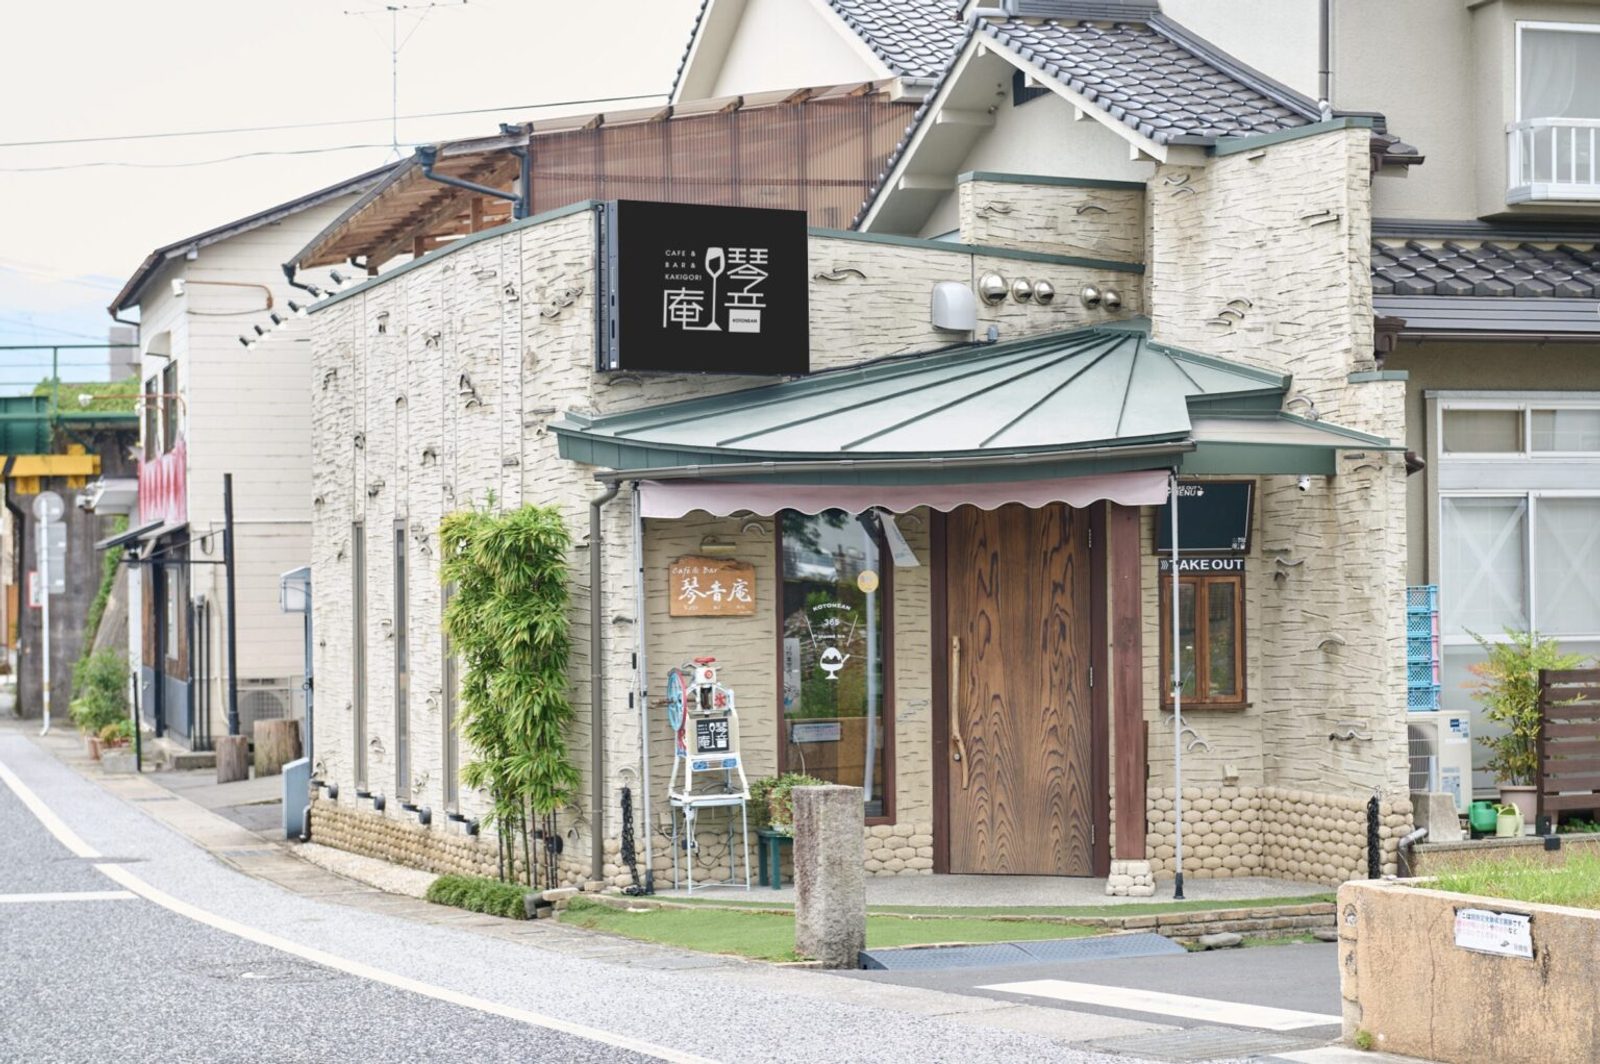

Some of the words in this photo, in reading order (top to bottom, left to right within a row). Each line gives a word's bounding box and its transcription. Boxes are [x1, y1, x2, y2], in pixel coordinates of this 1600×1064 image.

[664, 249, 686, 257] CAFE
[664, 273, 702, 281] KAKIGORI
[1211, 559, 1244, 570] OUT
[678, 576, 752, 605] 琴音庵
